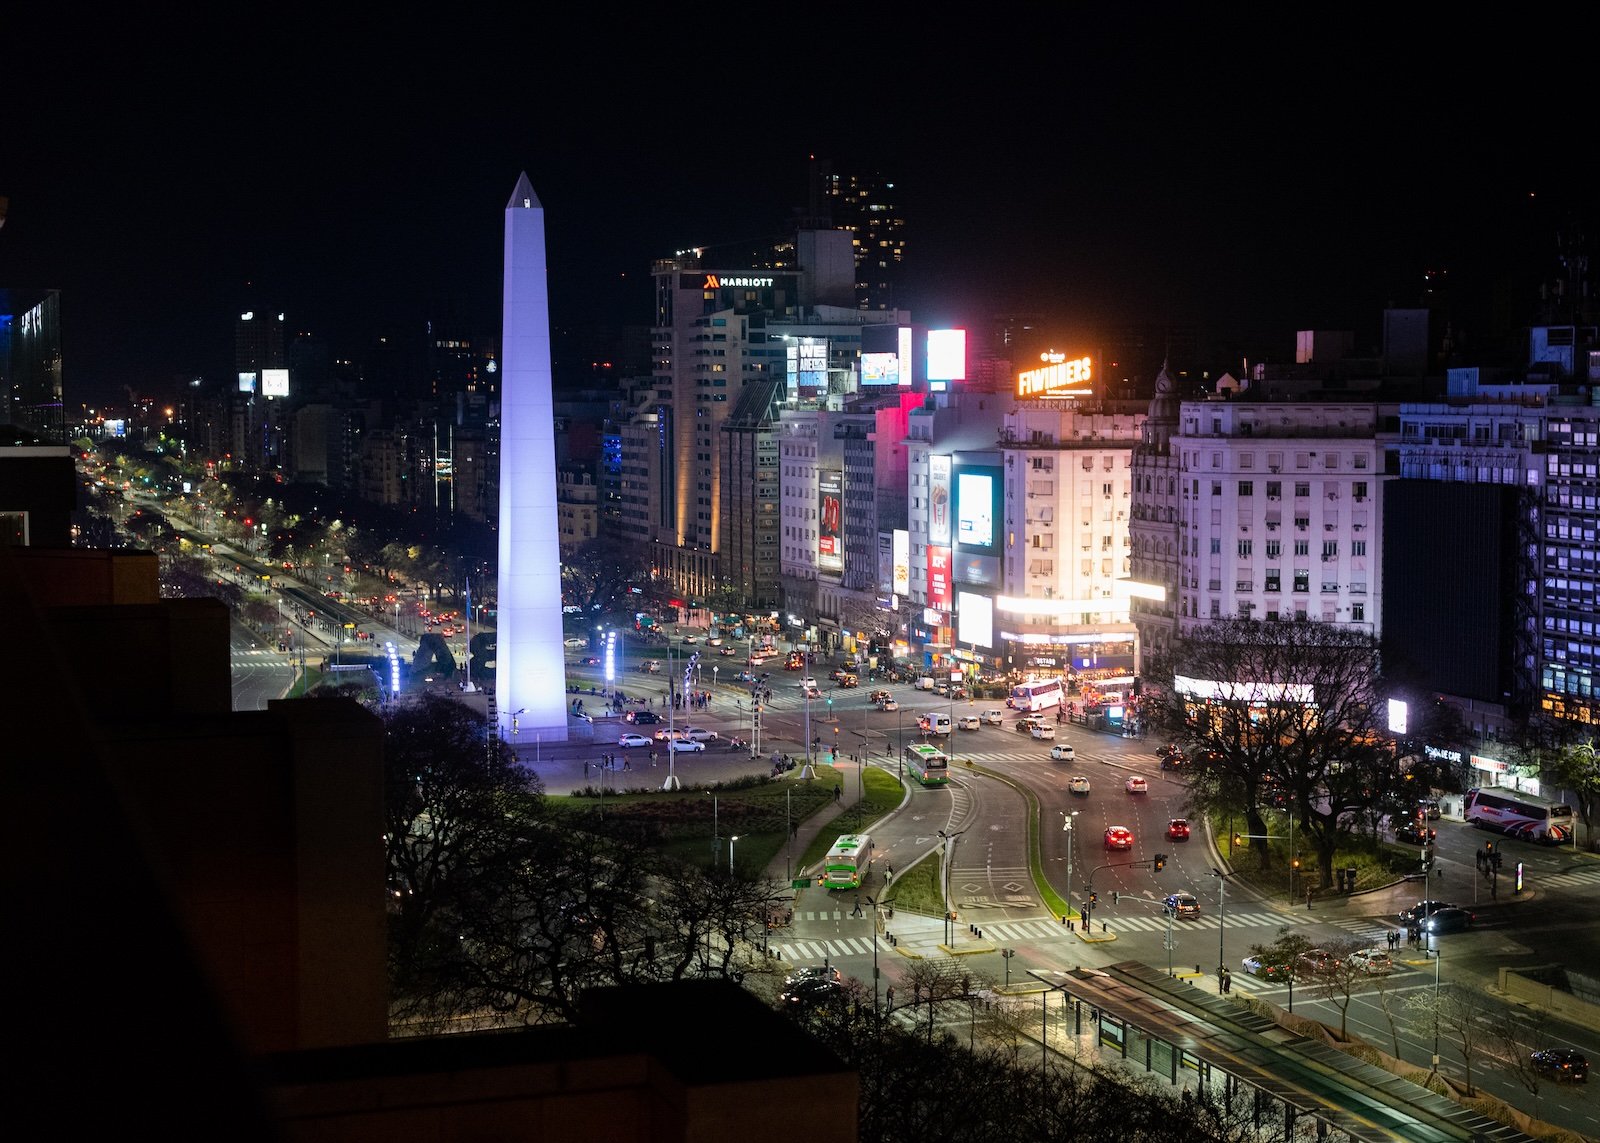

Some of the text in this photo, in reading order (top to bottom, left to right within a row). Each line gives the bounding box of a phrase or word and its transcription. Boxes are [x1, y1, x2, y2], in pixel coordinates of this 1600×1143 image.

[720, 278, 773, 287] MARRIOTT
[800, 345, 826, 357] WE
[1019, 357, 1091, 395] FIWINNERS
[932, 555, 946, 569] KFC
